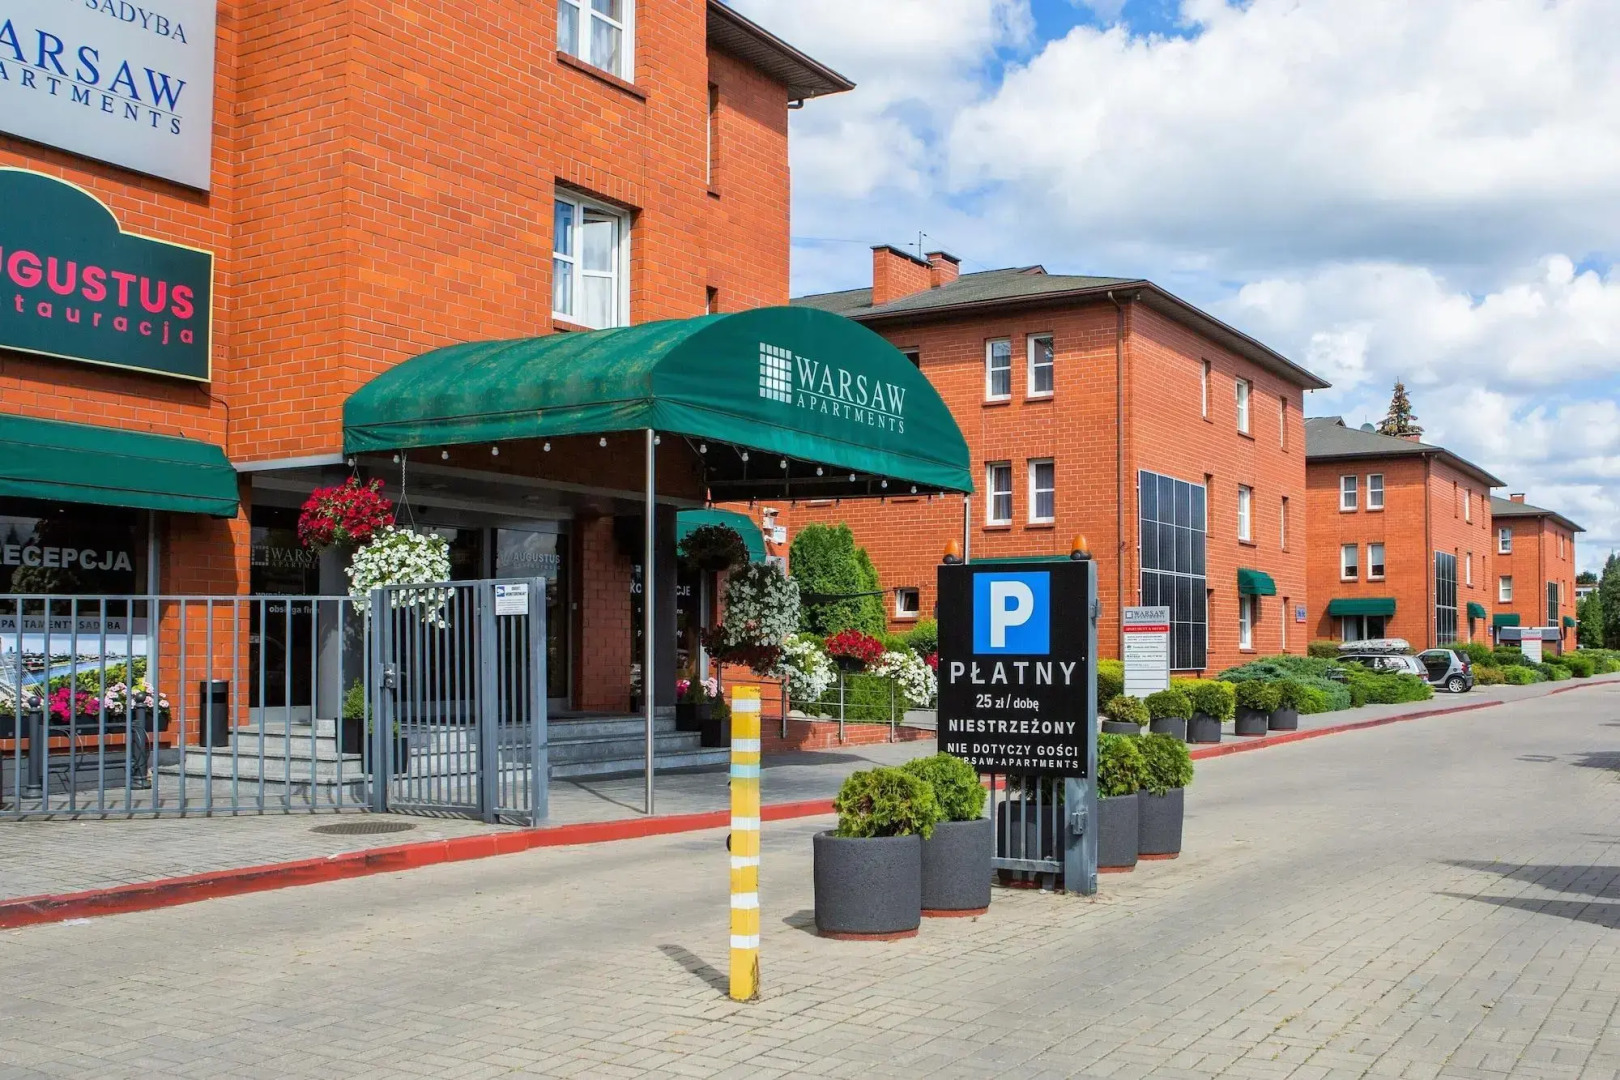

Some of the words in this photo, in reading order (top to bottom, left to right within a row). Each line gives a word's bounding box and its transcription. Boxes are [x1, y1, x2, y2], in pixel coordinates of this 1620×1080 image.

[0, 246, 195, 320] GUSTUS
[795, 355, 906, 415] WARSAW
[797, 393, 904, 434] APARTMENTS
[0, 544, 133, 572] ECEPCJA
[513, 551, 561, 564] AUGUSTUS
[79, 620, 121, 630] SADBA
[990, 580, 1034, 648] P
[950, 661, 1077, 685] PŁATNY
[975, 694, 992, 708] 25
[1013, 697, 1040, 712] dobę
[949, 718, 1076, 735] NIESTRZEŻONY
[947, 742, 967, 754] NIE
[973, 744, 1031, 756] DOTYCZY
[1037, 743, 1078, 757] GOŚCI
